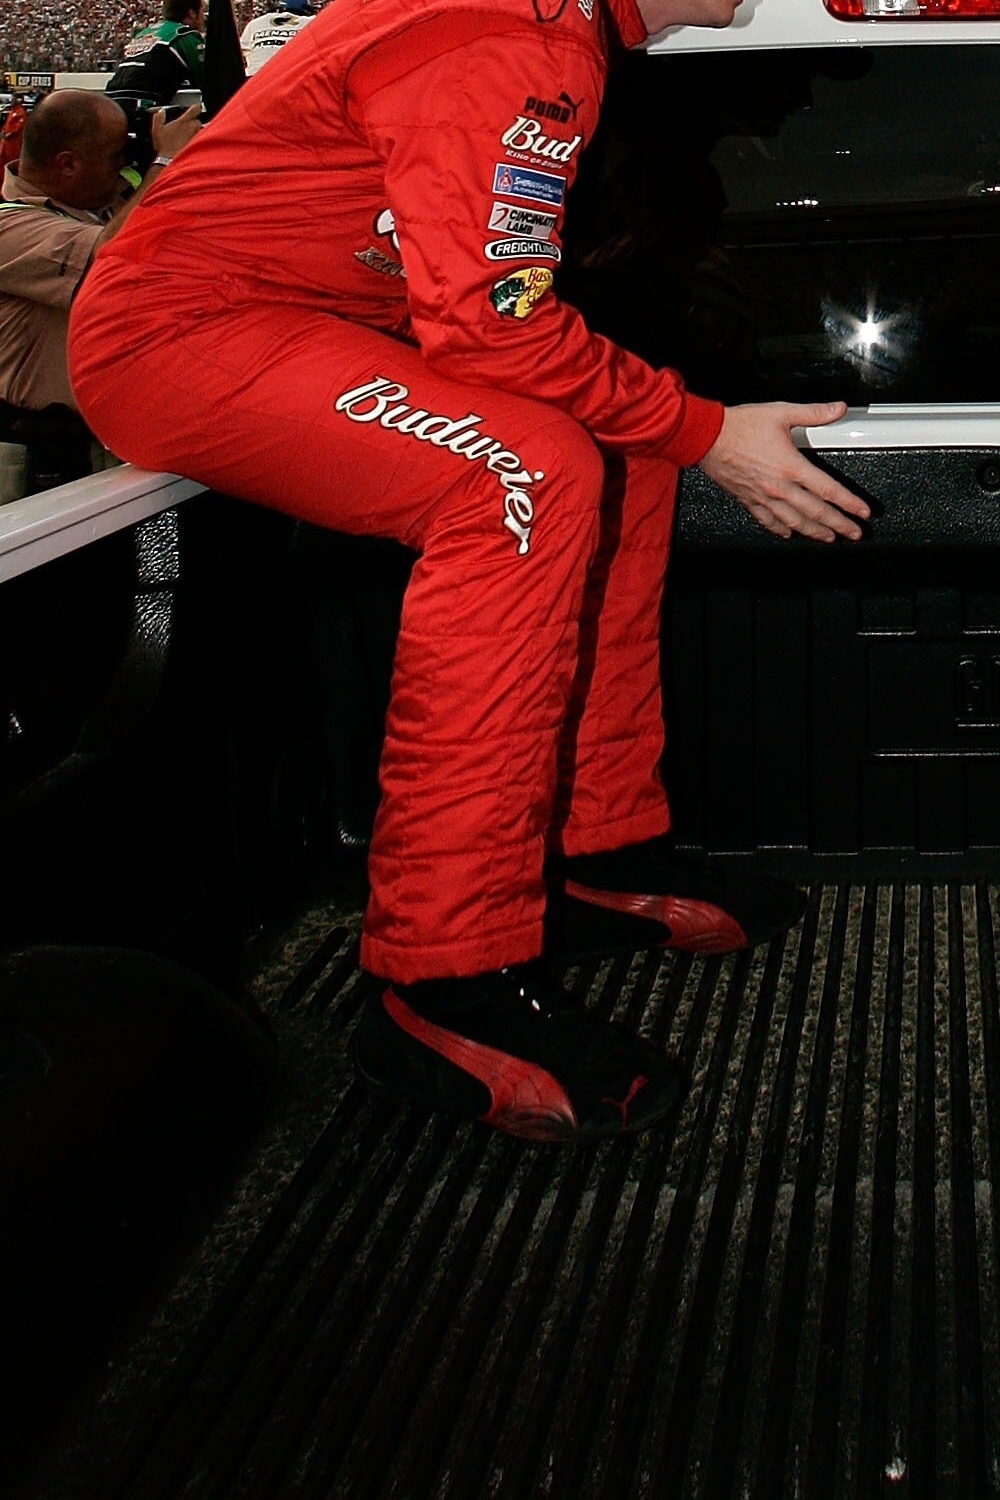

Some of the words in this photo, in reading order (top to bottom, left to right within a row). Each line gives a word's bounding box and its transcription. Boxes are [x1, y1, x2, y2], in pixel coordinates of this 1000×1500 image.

[18, 75, 30, 86] CUP
[31, 76, 52, 87] SERIES
[501, 115, 582, 162] Bud
[506, 220, 534, 235] LAMB
